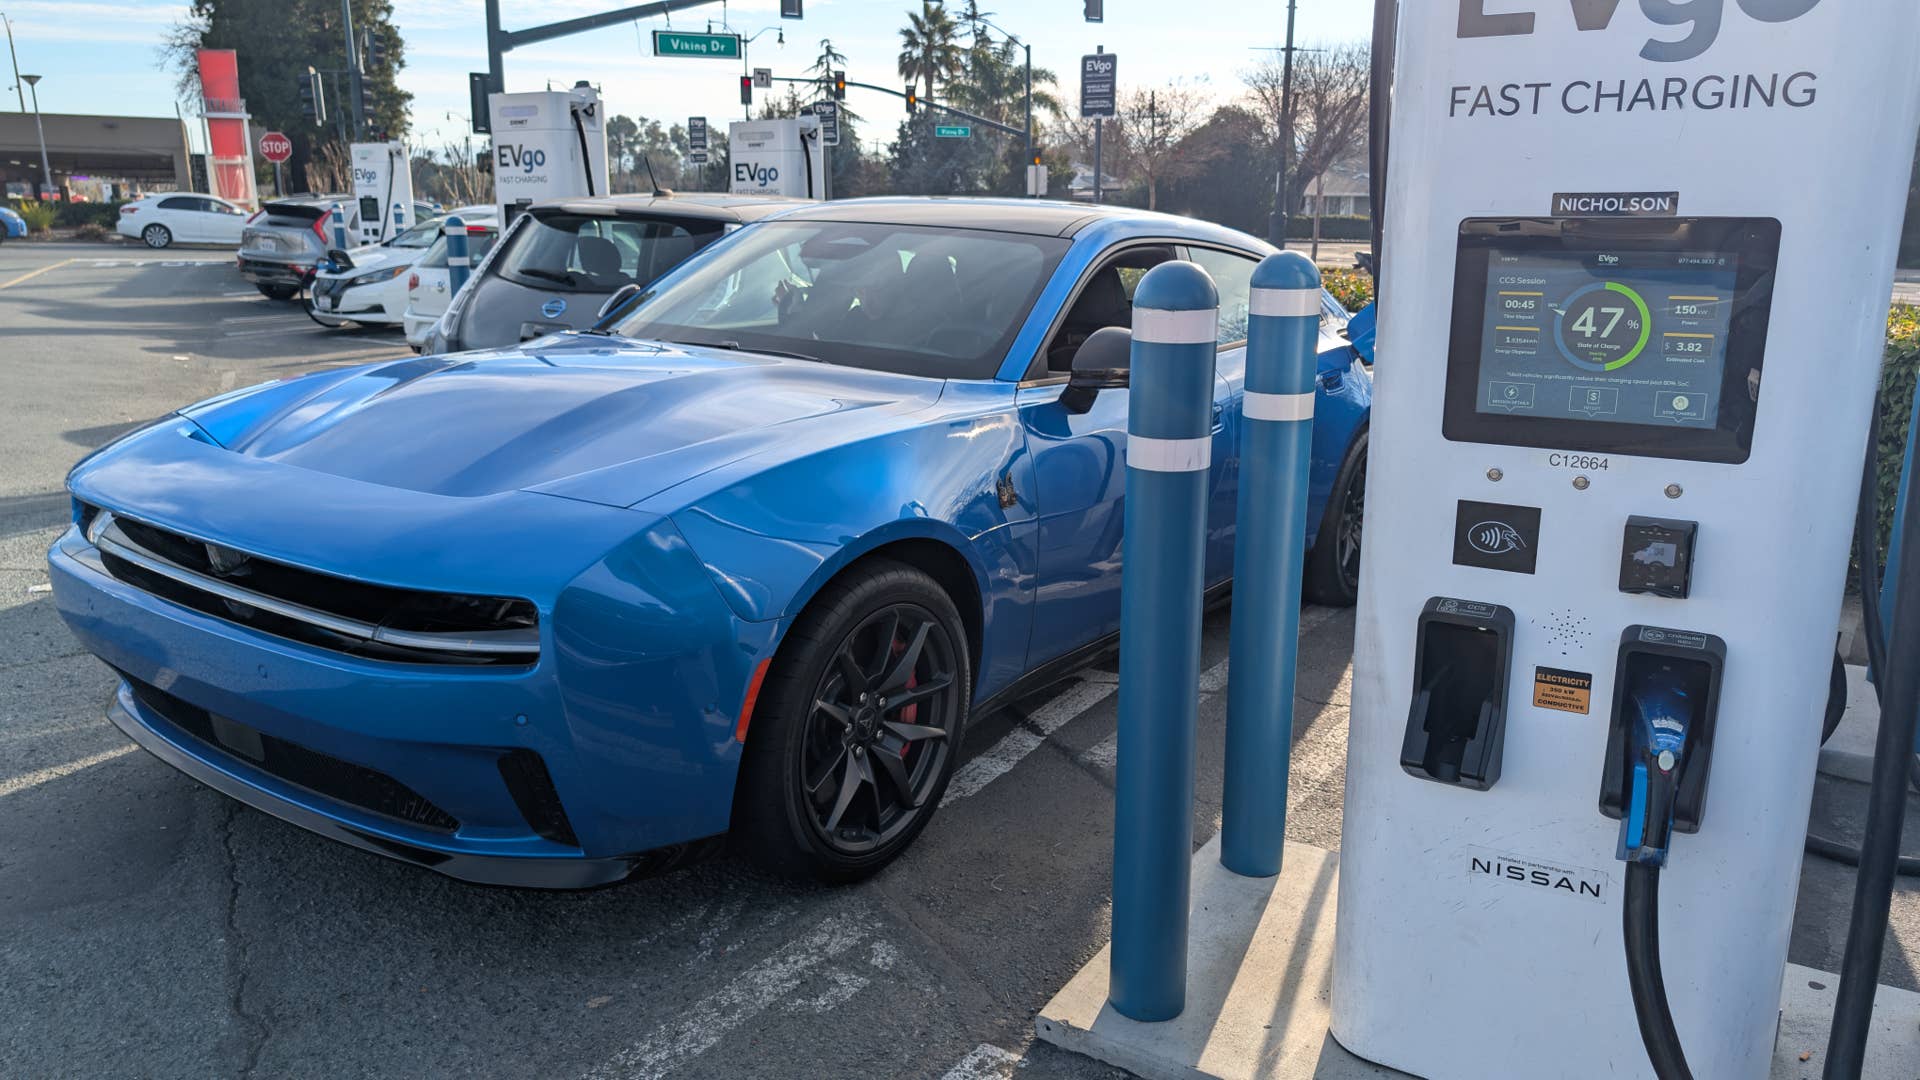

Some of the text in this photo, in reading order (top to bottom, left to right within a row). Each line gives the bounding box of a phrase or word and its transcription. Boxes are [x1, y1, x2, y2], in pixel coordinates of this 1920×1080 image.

[670, 38, 726, 53] Viking Dr
[1086, 60, 1112, 74] EVgo
[1448, 71, 1819, 118] FAST CHARGING
[262, 140, 290, 154] STOP
[498, 144, 546, 173] EVgo
[354, 168, 377, 184] EVgo
[515, 175, 548, 184] CHARGING
[735, 162, 779, 187] EVgo
[1558, 196, 1672, 213] NICHOLSON
[1598, 254, 1619, 264] EVgo
[1499, 276, 1546, 286] CCS Session
[1505, 299, 1536, 310] 00:45
[1674, 305, 1697, 315] 150
[1571, 306, 1640, 339] 47 %
[1576, 342, 1592, 350] State
[1600, 342, 1621, 352] Charge
[1676, 341, 1703, 353] 3.82
[1549, 453, 1610, 471] C12664
[1536, 672, 1591, 688] ELECTRICITY
[1537, 698, 1585, 711] CONDUCTIVE
[1527, 860, 1562, 873] partnership
[1562, 868, 1576, 876] with
[1471, 857, 1601, 898] NISSAN
